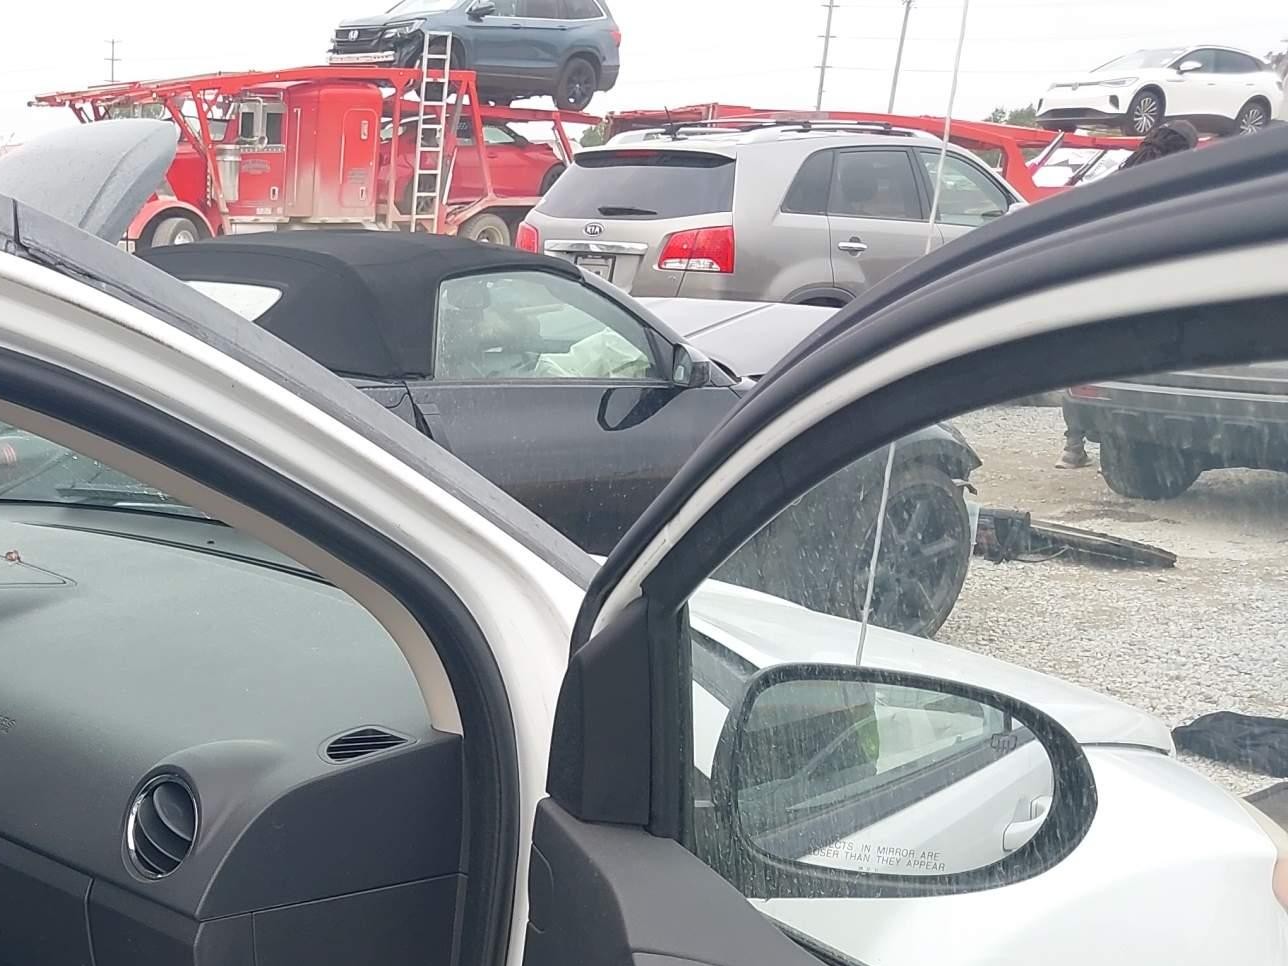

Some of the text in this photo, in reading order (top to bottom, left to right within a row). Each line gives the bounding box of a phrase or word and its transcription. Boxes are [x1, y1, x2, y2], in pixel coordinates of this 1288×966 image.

[807, 847, 946, 871] OSER THAN THEY APPEAR
[861, 844, 872, 853] IN
[877, 846, 915, 858] MIRROR
[920, 851, 941, 861] ARE
